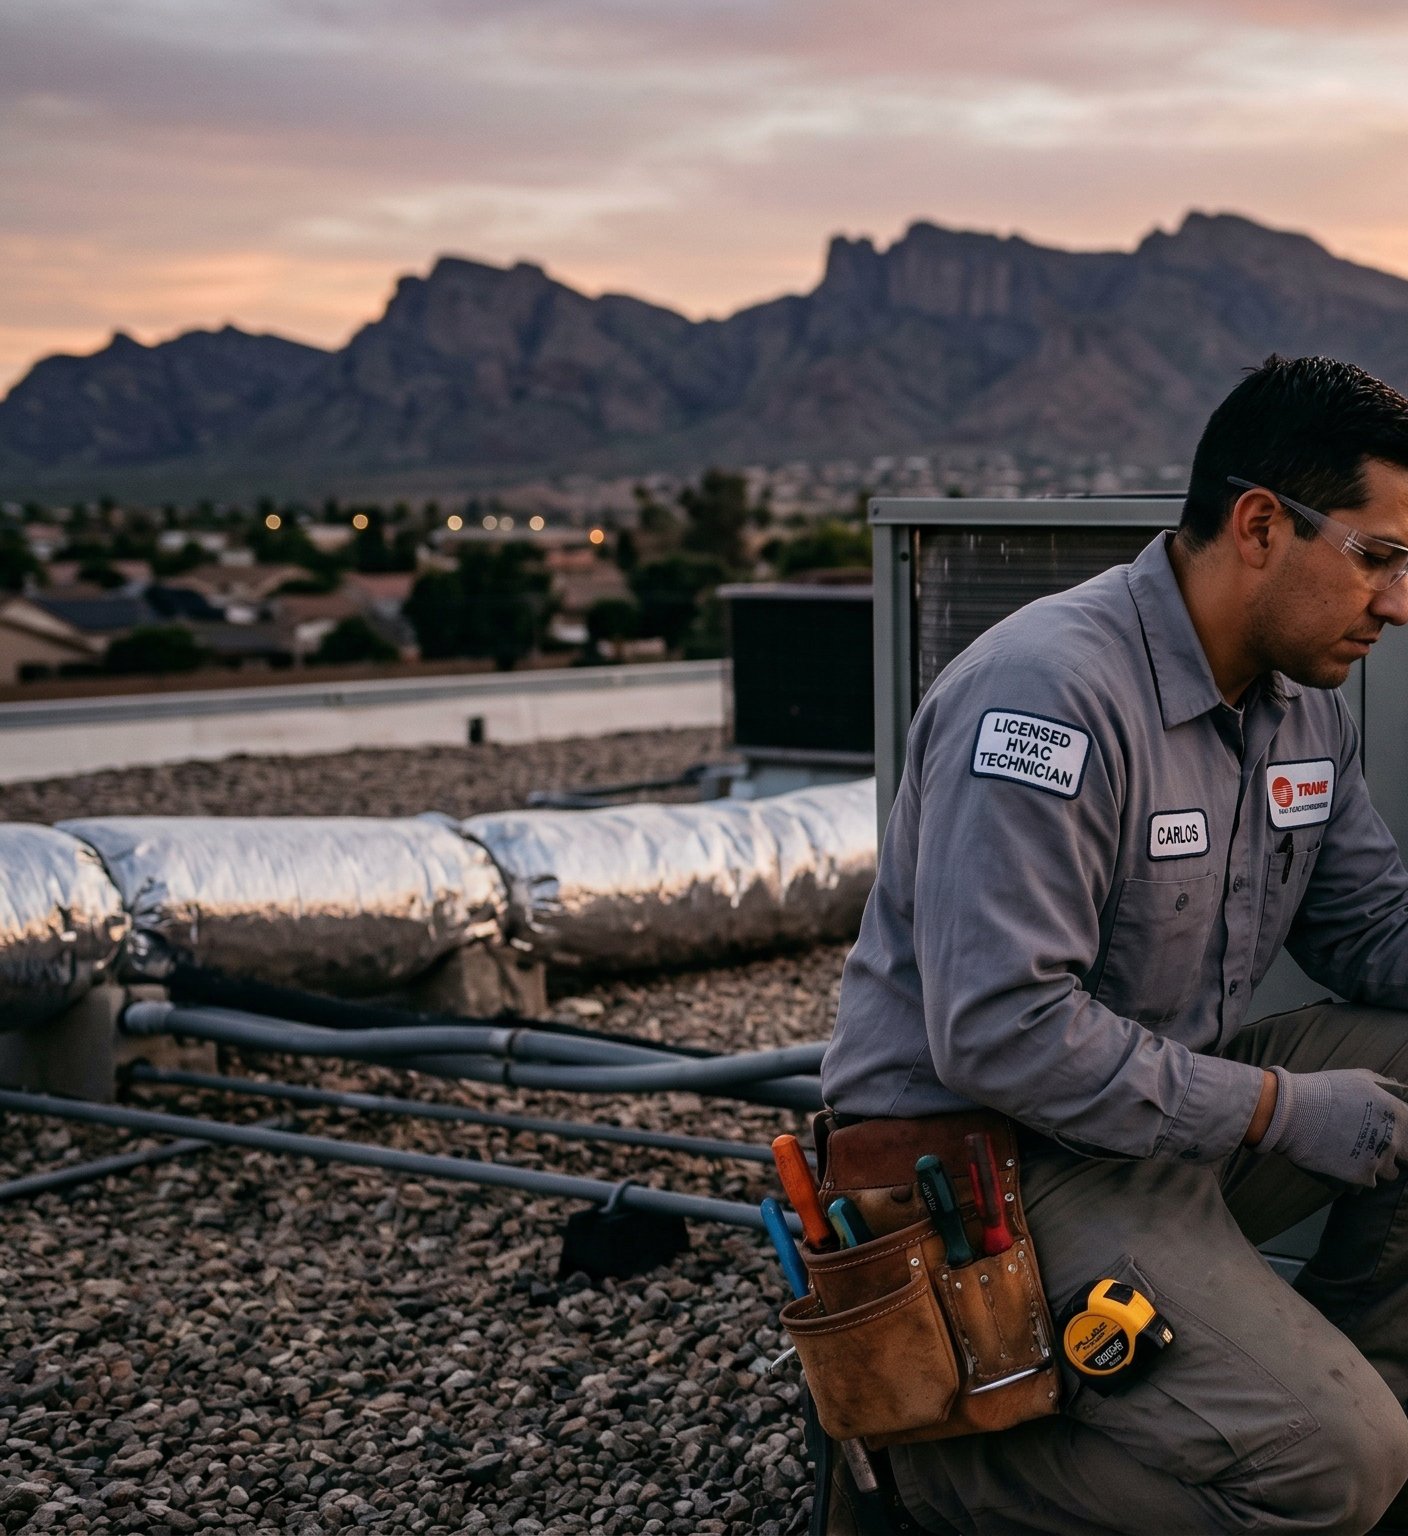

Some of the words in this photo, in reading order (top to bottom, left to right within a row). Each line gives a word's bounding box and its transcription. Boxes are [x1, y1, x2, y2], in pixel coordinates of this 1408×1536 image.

[994, 718, 1071, 748] LICENSED
[1005, 737, 1053, 761] HVAC
[979, 752, 1073, 788] TECHNICIAN
[1157, 824, 1199, 845] CARLOS
